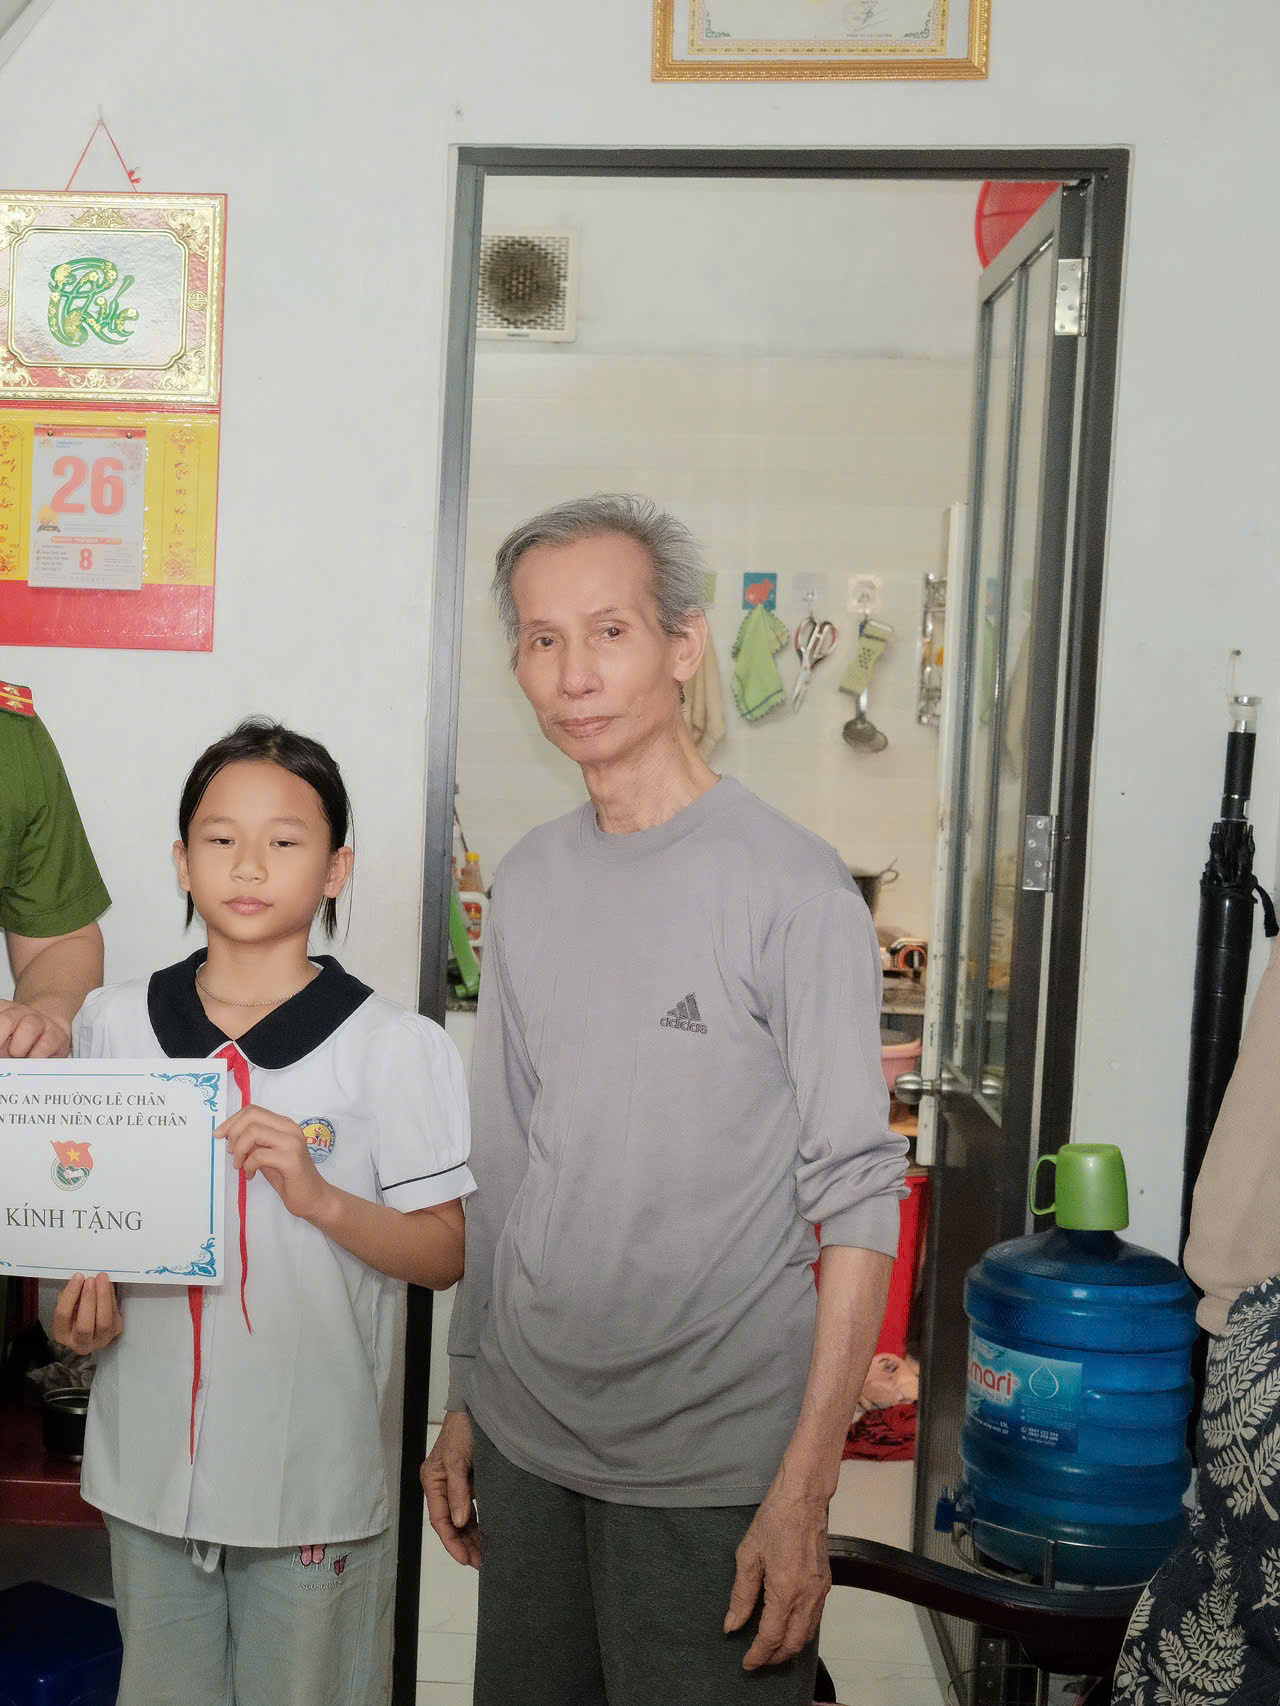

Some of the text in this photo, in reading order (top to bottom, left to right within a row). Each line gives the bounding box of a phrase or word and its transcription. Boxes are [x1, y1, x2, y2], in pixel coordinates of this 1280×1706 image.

[50, 455, 127, 517] 26
[79, 548, 93, 571] 8
[660, 1016, 708, 1034] adidas
[22, 1094, 40, 1105] AN
[44, 1091, 102, 1106] PHƯỜNG
[106, 1091, 123, 1106] LÊ
[126, 1091, 166, 1106] CHÂN
[9, 1113, 56, 1125] THANH
[60, 1111, 92, 1126] NIÊN
[96, 1114, 123, 1126] CAP
[127, 1111, 144, 1126] LÊ
[147, 1112, 187, 1127] CHÂN
[6, 1202, 143, 1234] KÍNH TẶNG
